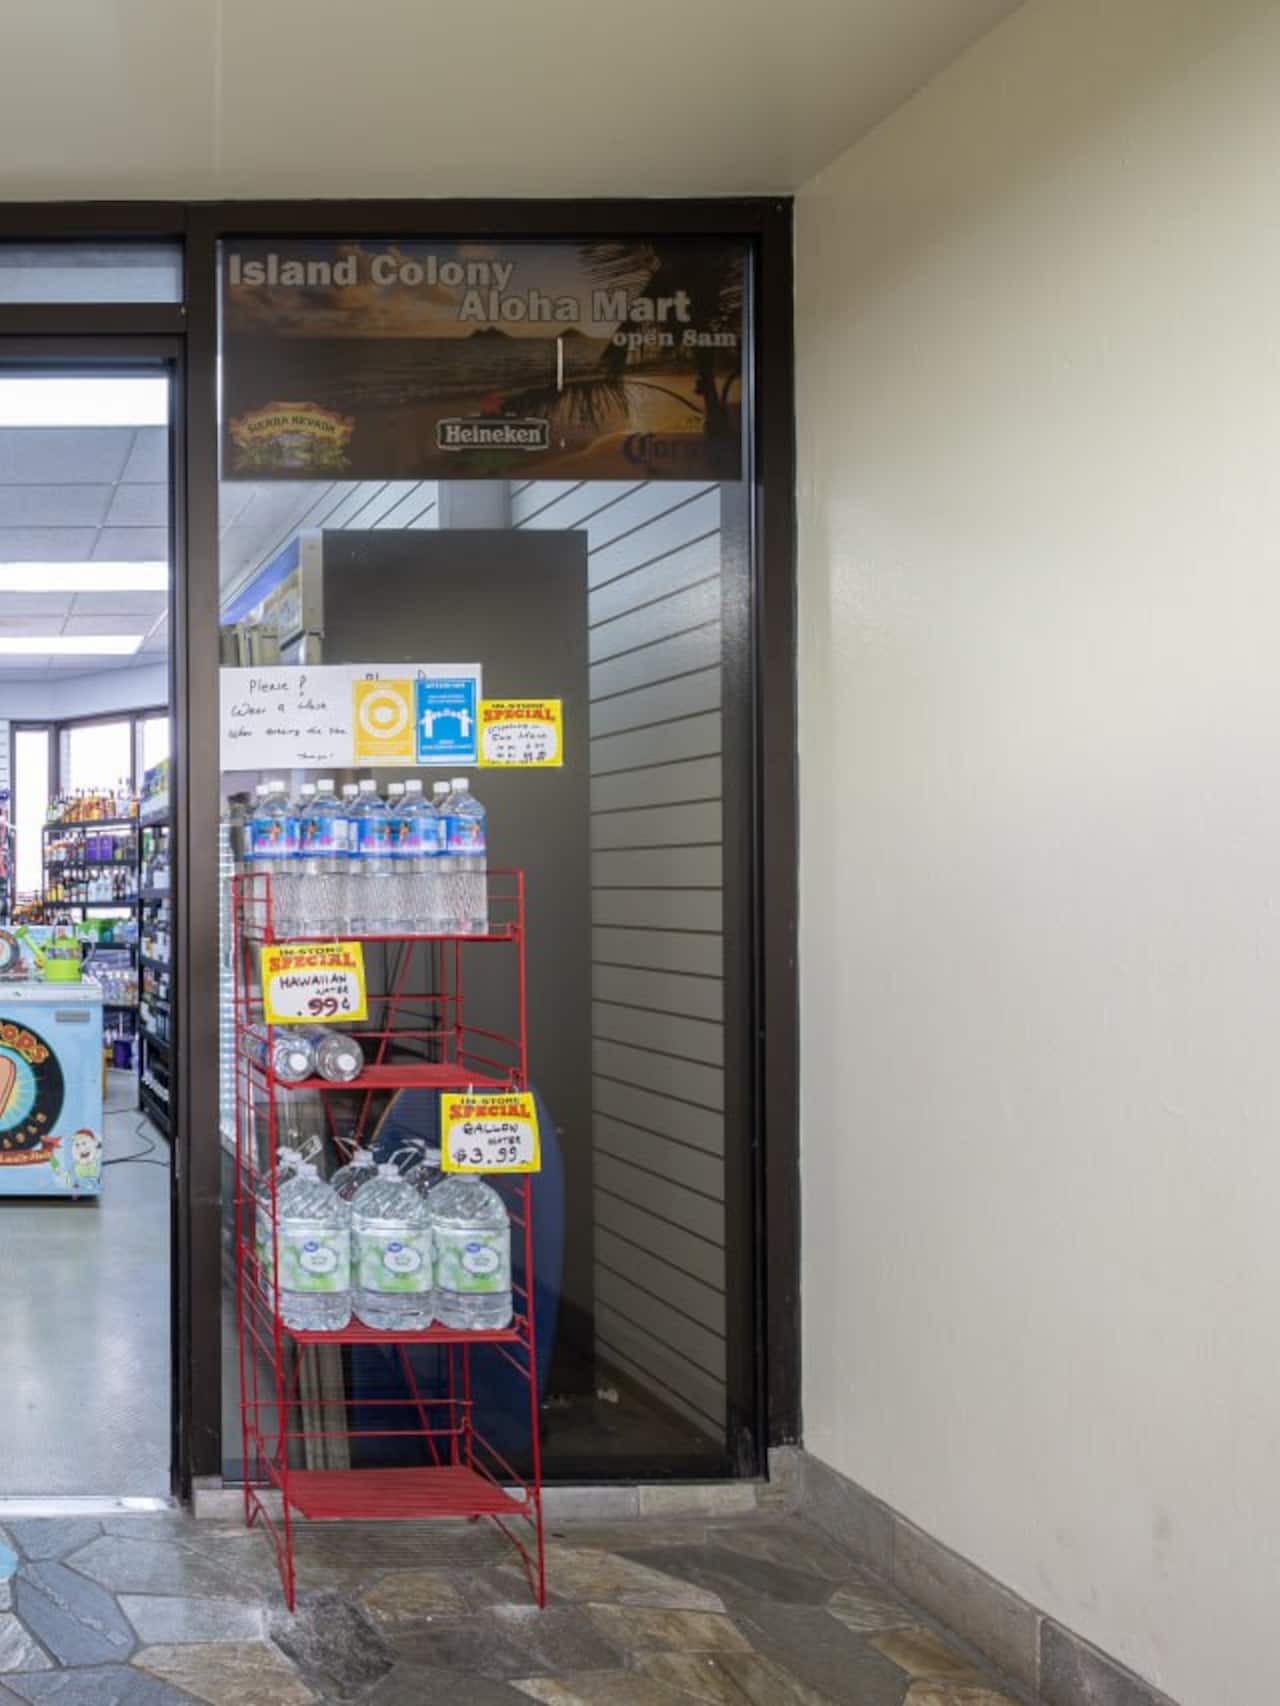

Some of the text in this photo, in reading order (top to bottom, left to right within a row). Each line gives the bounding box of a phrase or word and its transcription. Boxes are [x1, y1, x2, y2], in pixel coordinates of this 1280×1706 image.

[228, 253, 513, 292] Island Colony
[459, 288, 691, 322] Aloha Mart
[613, 329, 737, 351] open 8am
[445, 423, 542, 444] Heineken
[483, 708, 556, 722] SPECIAL
[269, 952, 357, 973] SPECIAL
[279, 973, 347, 990] HAWAIIAN
[450, 1103, 531, 1120] SPECIAL
